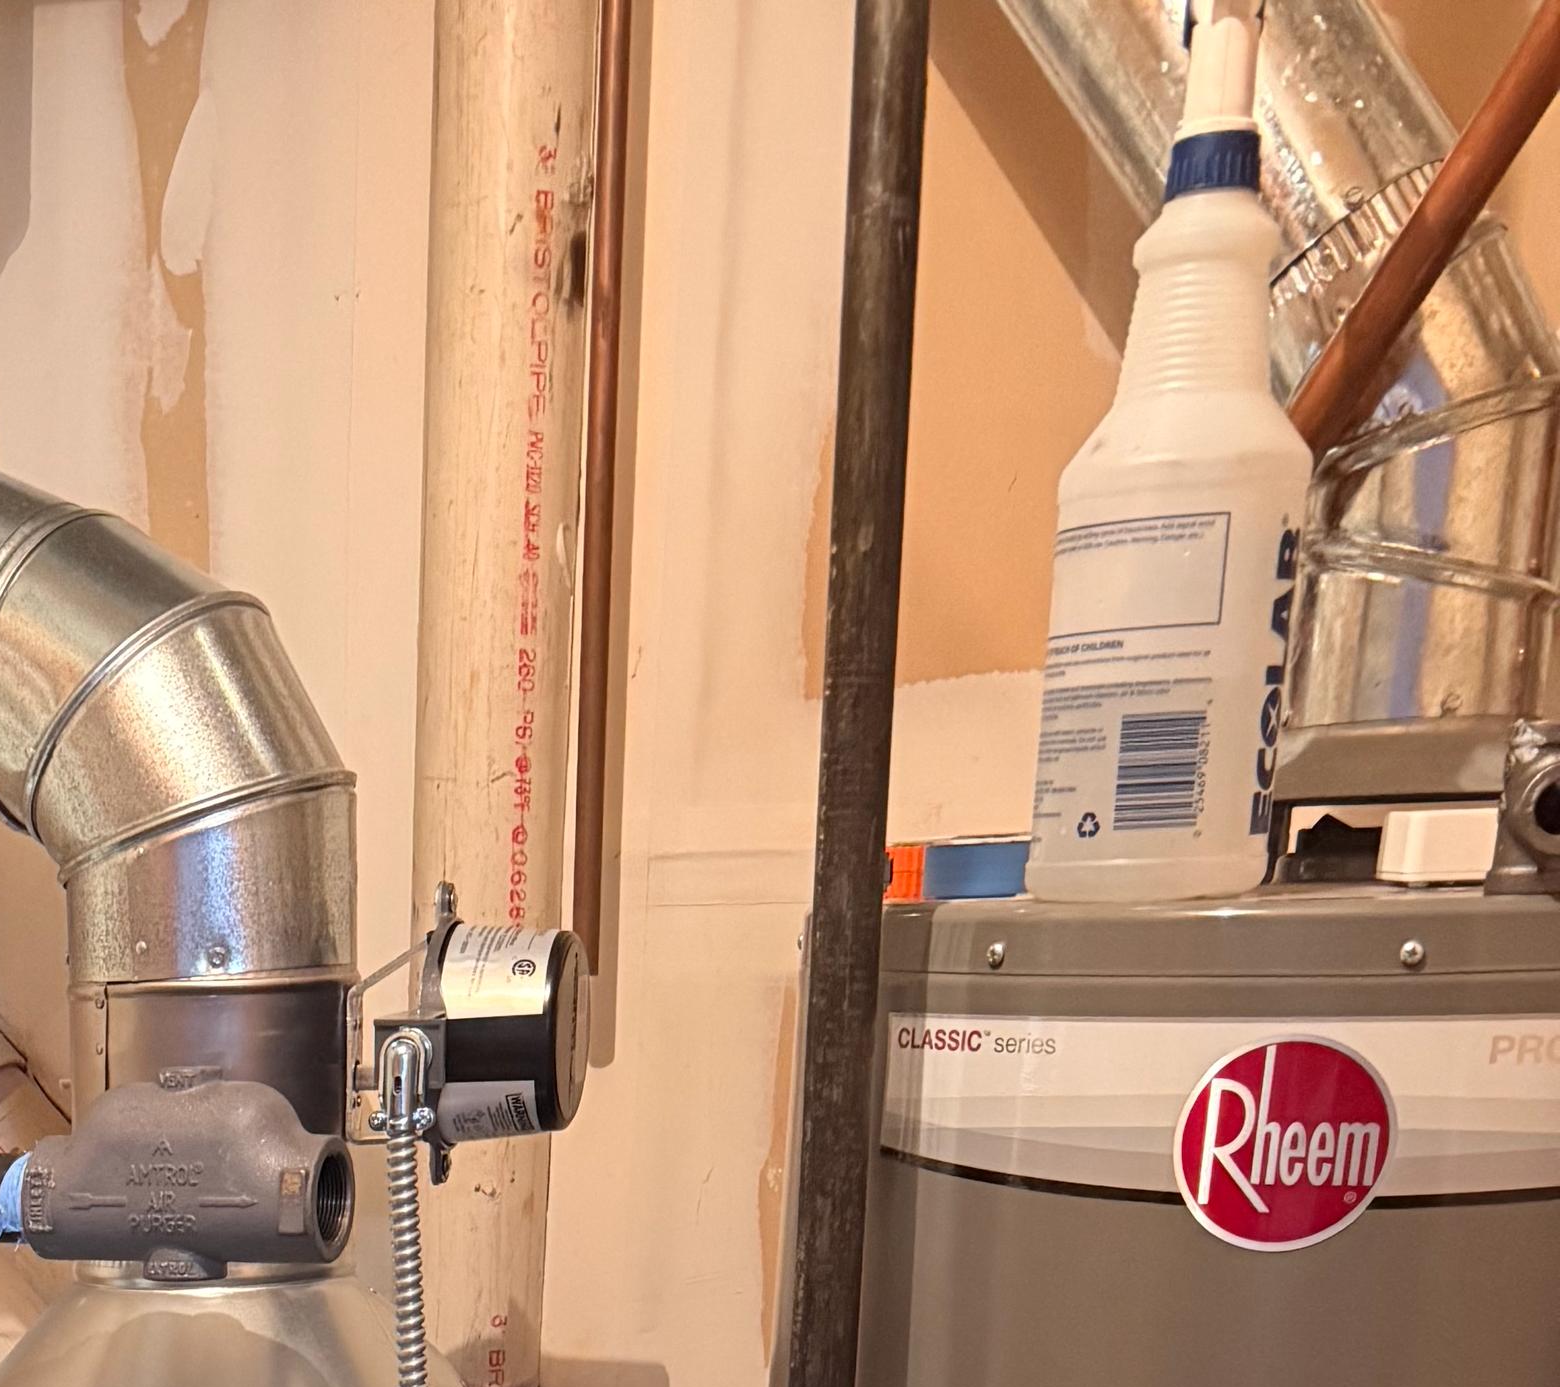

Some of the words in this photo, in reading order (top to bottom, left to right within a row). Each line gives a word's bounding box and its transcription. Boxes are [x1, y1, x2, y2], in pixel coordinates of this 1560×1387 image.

[898, 1029, 982, 1053] CLASSIC
[994, 1033, 1056, 1056] series
[159, 1069, 195, 1088] VENT
[1198, 1045, 1380, 1214] Rheem
[126, 1162, 198, 1187] AMTROL
[146, 1191, 176, 1213] AIR
[127, 1213, 196, 1233] PURGER
